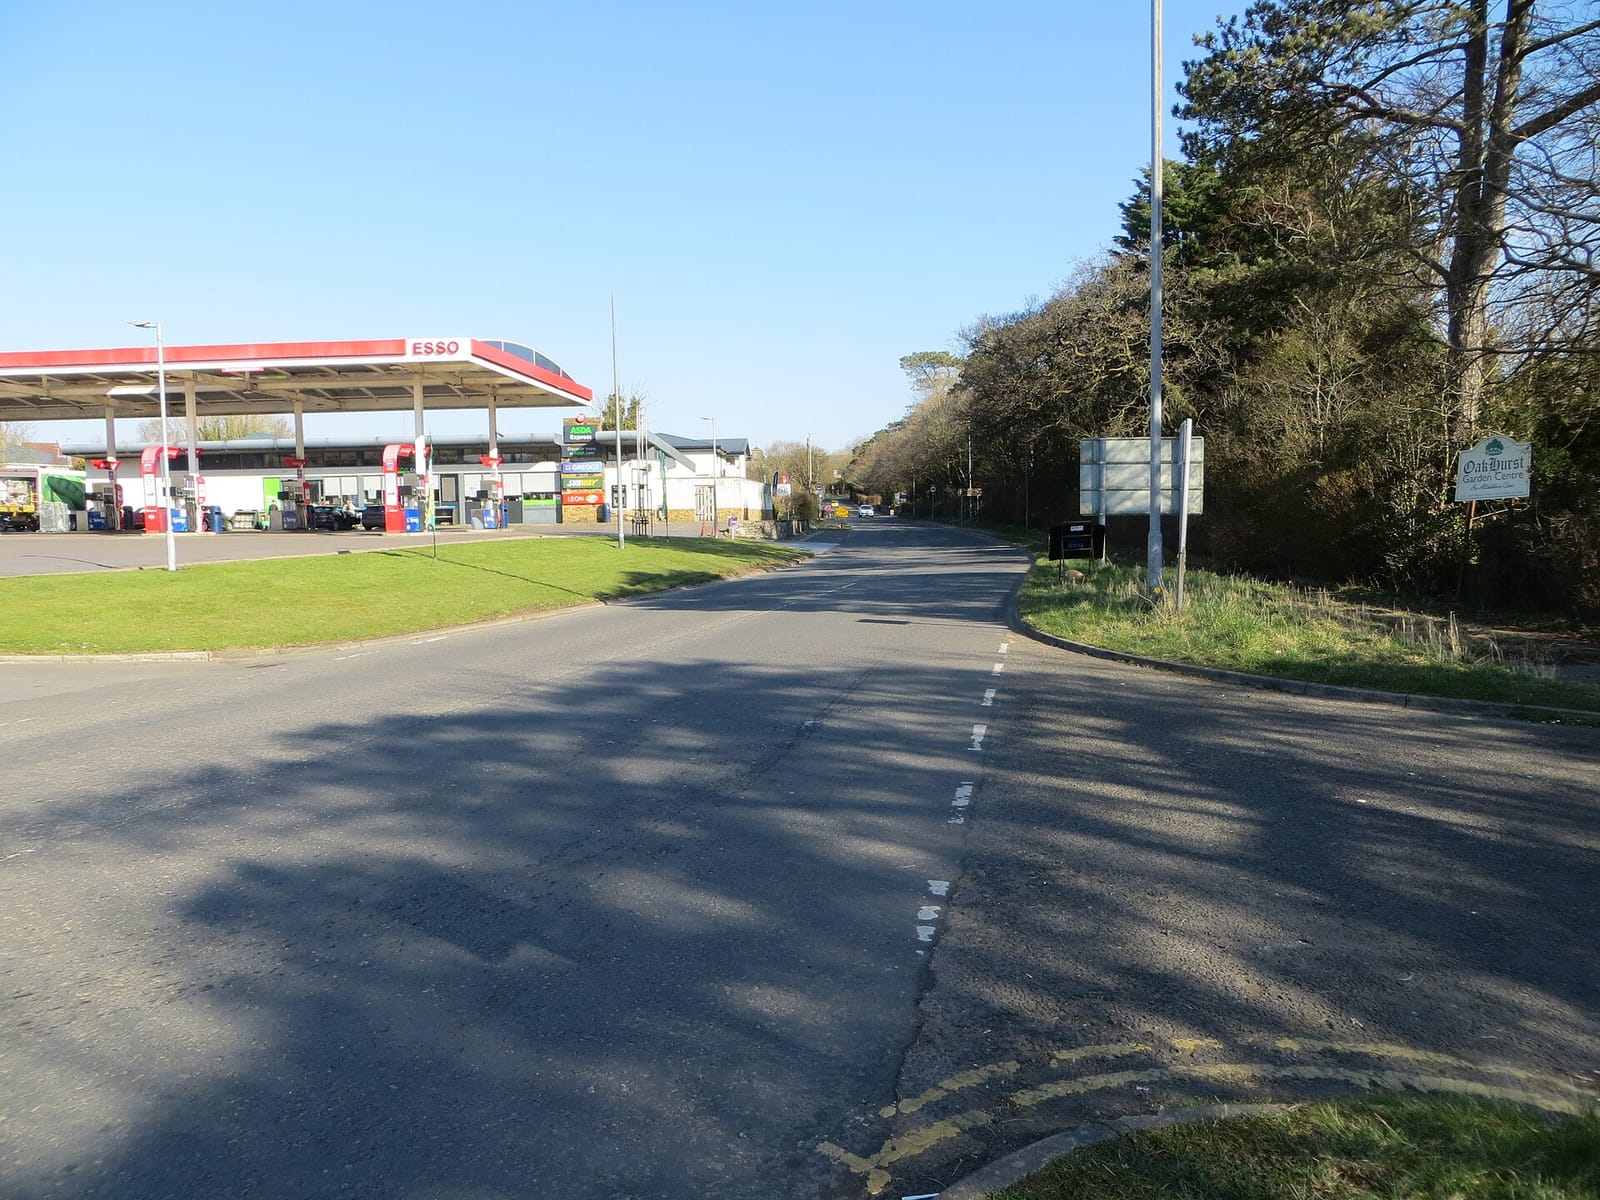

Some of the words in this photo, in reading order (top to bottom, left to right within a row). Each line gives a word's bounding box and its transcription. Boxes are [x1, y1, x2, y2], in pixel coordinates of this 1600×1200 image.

[412, 341, 459, 355] ESSO
[570, 426, 592, 434] ASDA
[572, 463, 599, 471] GREGGS
[1463, 474, 1492, 484] Garden
[1495, 471, 1523, 481] Centre
[567, 479, 598, 487] SUBWAY
